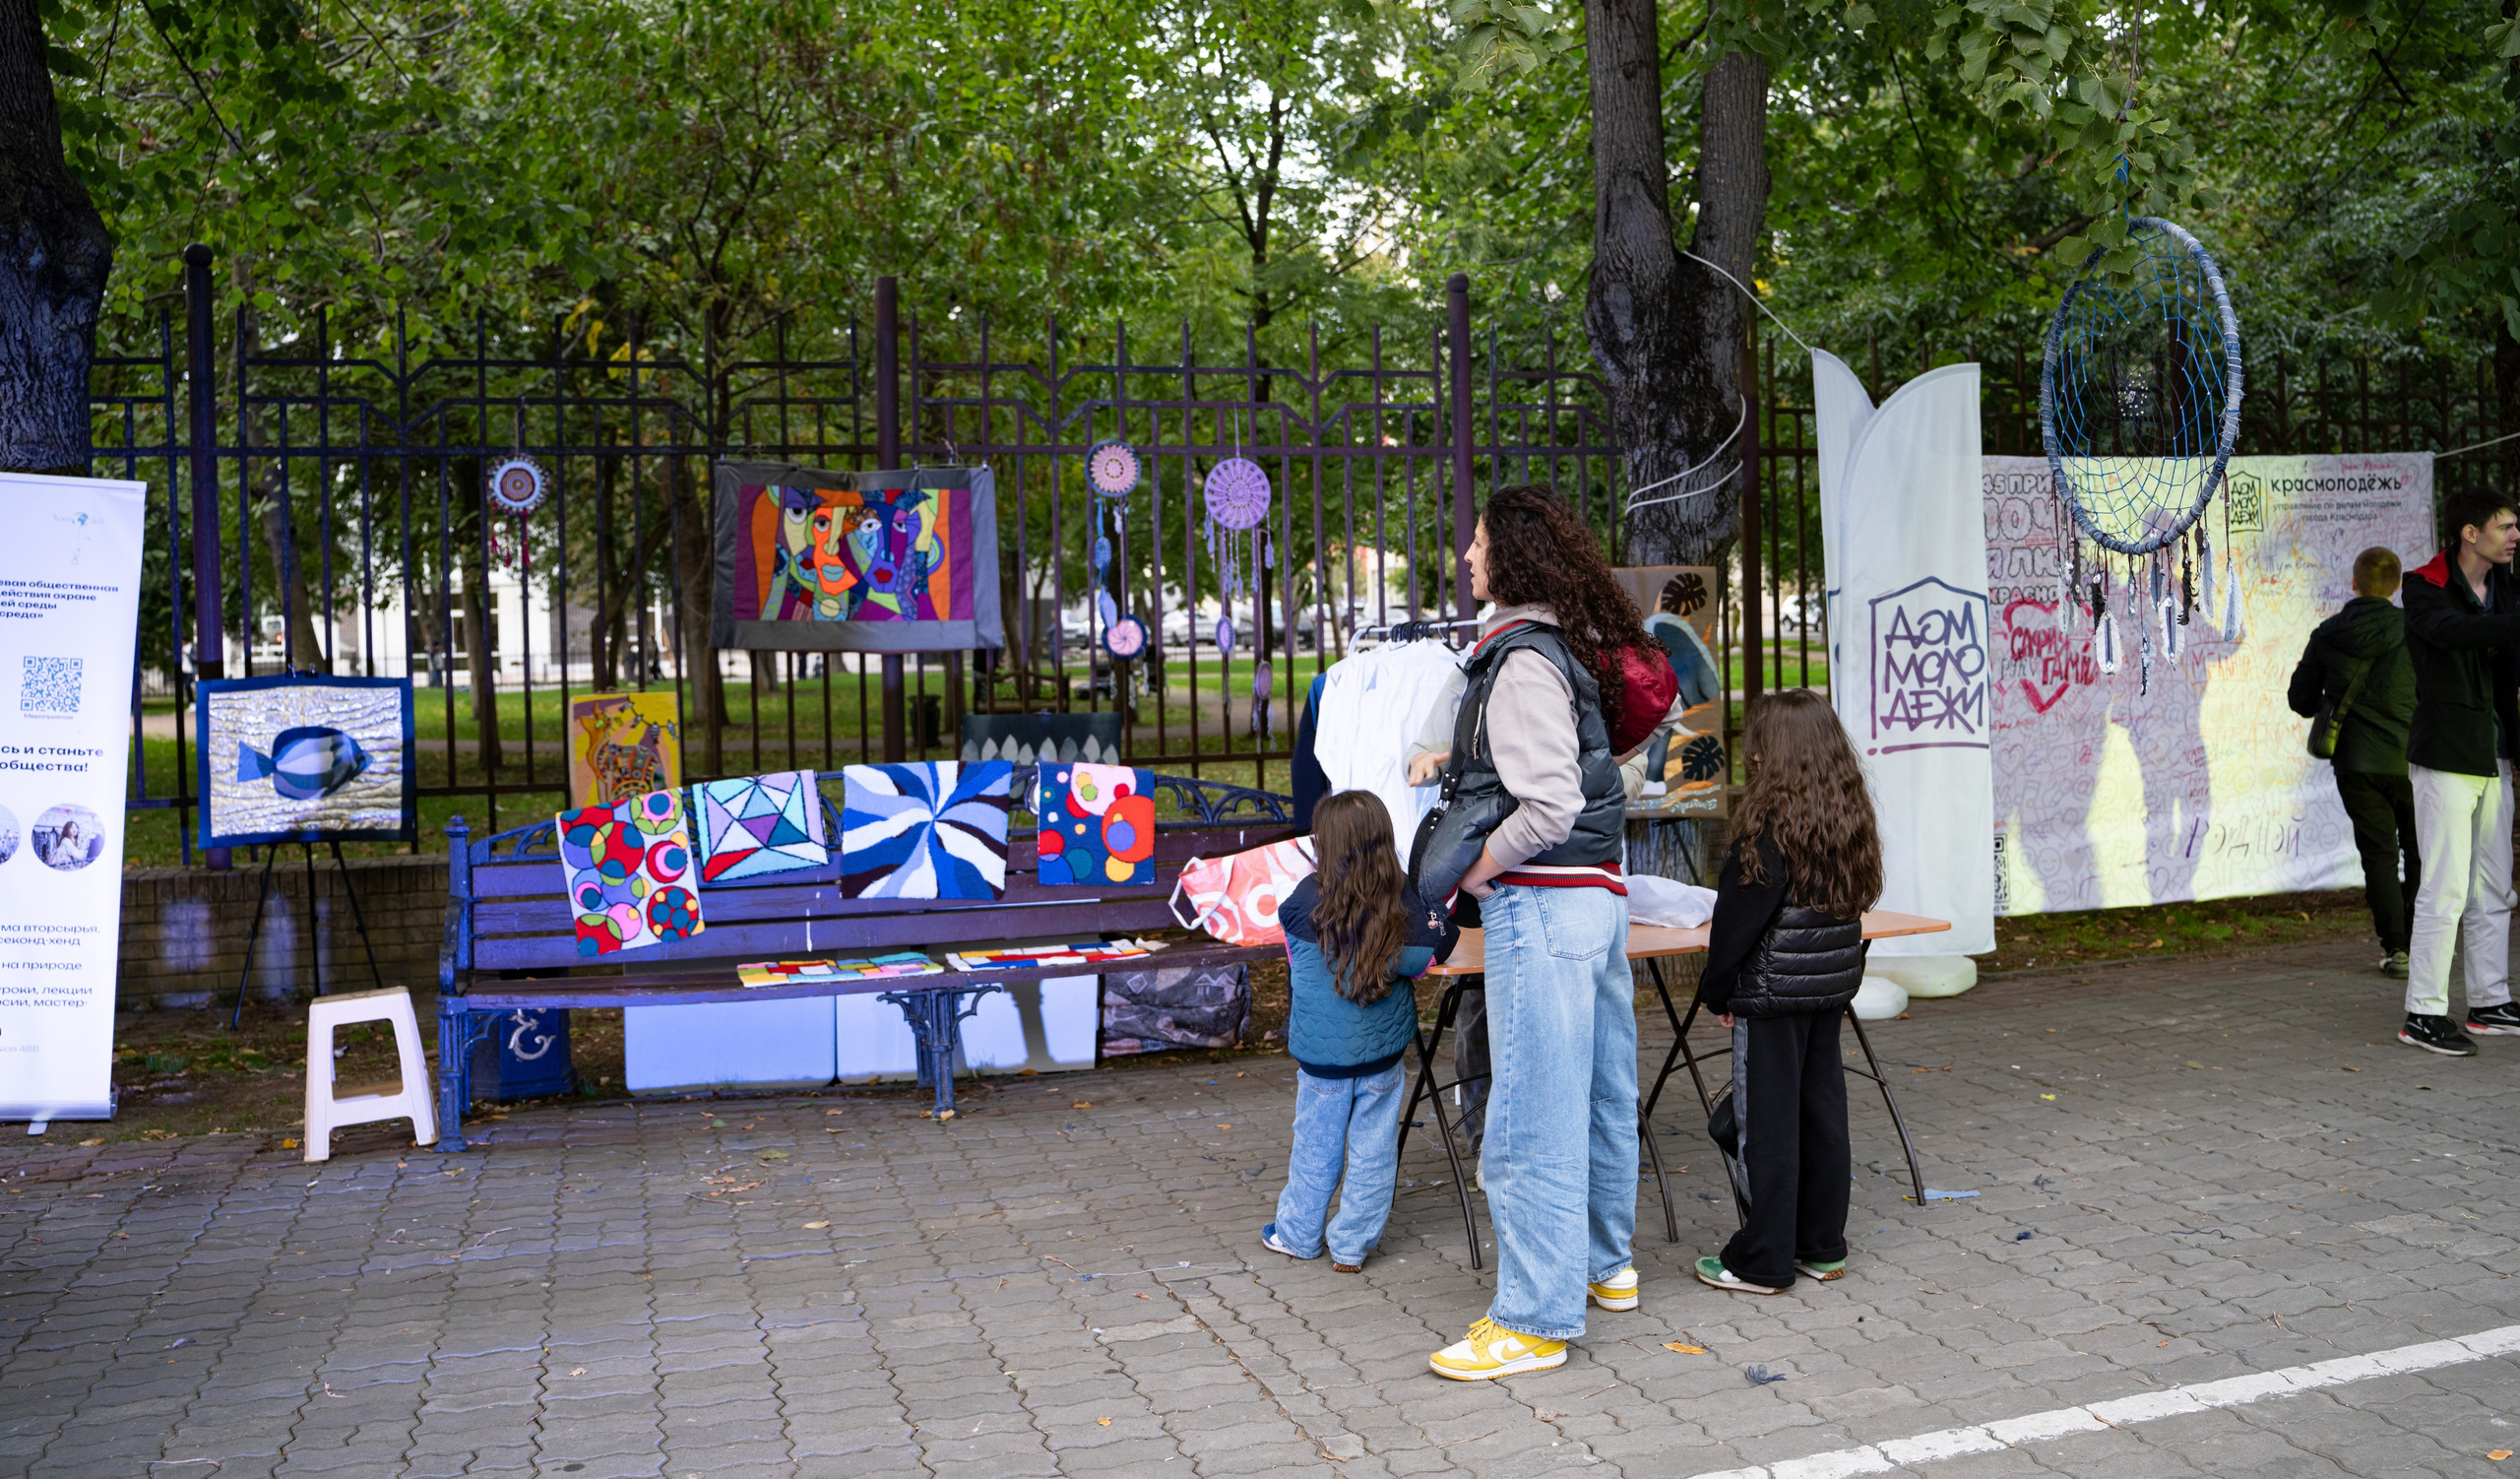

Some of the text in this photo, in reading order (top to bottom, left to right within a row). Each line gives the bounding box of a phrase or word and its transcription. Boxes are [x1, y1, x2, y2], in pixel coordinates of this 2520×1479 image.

[2231, 480, 2256, 496] ДОМ
[2270, 473, 2402, 497] красмолодёжь
[2273, 500, 2322, 512] управление
[2324, 500, 2335, 510] по
[2336, 500, 2362, 510] делам
[2302, 511, 2378, 524] города Краснодара
[29, 580, 119, 593] общественная
[0, 589, 97, 602] ействия охране
[1988, 585, 2096, 605] КРАСНОР
[18, 601, 57, 610] среды
[1883, 600, 1979, 651] ДОМ
[1881, 643, 1985, 694] МОЛО
[1879, 681, 1985, 737] ДЕЖИ
[24, 712, 74, 721] Мероприятия
[38, 746, 103, 757] станьте
[0, 759, 89, 772] общества!
[24, 925, 100, 934] вторсырья,
[23, 962, 83, 971] природе
[0, 987, 94, 996] роки, лекции
[0, 998, 89, 1008] сии, мастер-
